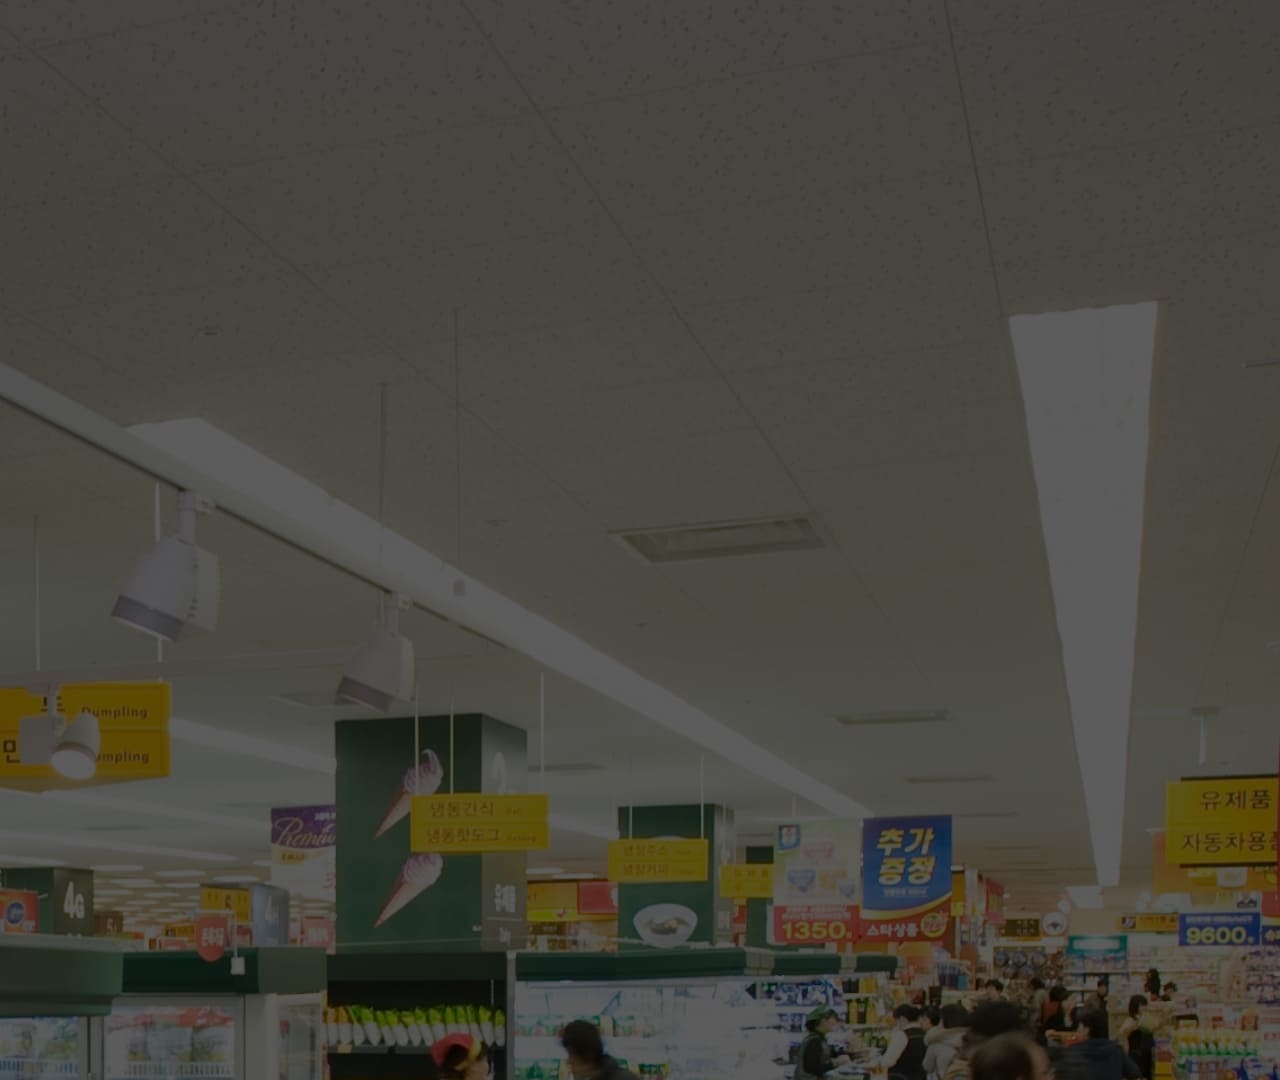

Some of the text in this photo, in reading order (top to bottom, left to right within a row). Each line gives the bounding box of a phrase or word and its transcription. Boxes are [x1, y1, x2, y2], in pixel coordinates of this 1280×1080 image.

[96, 751, 150, 764] umpling
[1200, 789, 1272, 811] 유제품
[876, 826, 936, 857] 추가
[878, 856, 937, 886] 증정
[1186, 926, 1247, 944] 9600
